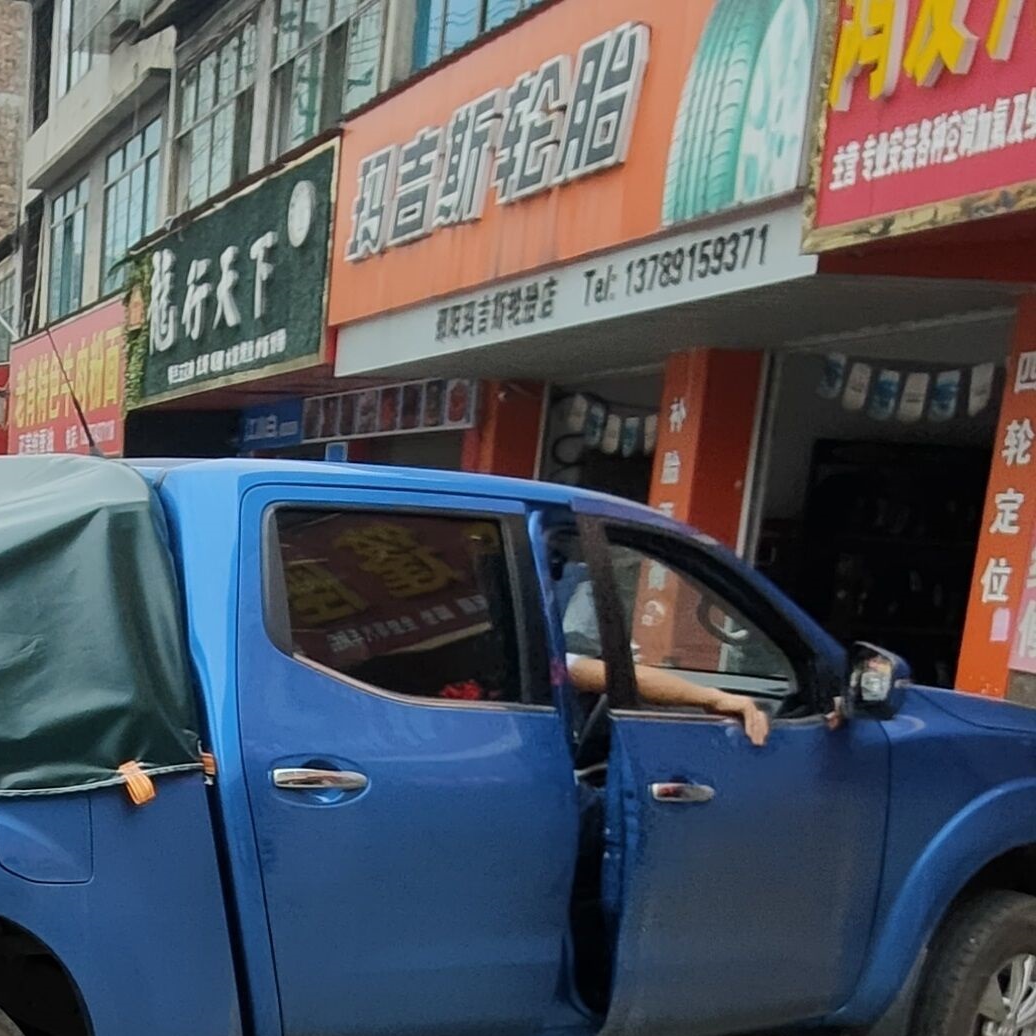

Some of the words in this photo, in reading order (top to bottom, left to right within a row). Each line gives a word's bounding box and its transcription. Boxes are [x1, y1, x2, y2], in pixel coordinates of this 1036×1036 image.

[344, 21, 652, 262] 玛吉斯轮胎
[624, 222, 770, 297] 13789159371
[980, 351, 1036, 604] 四轮定位
